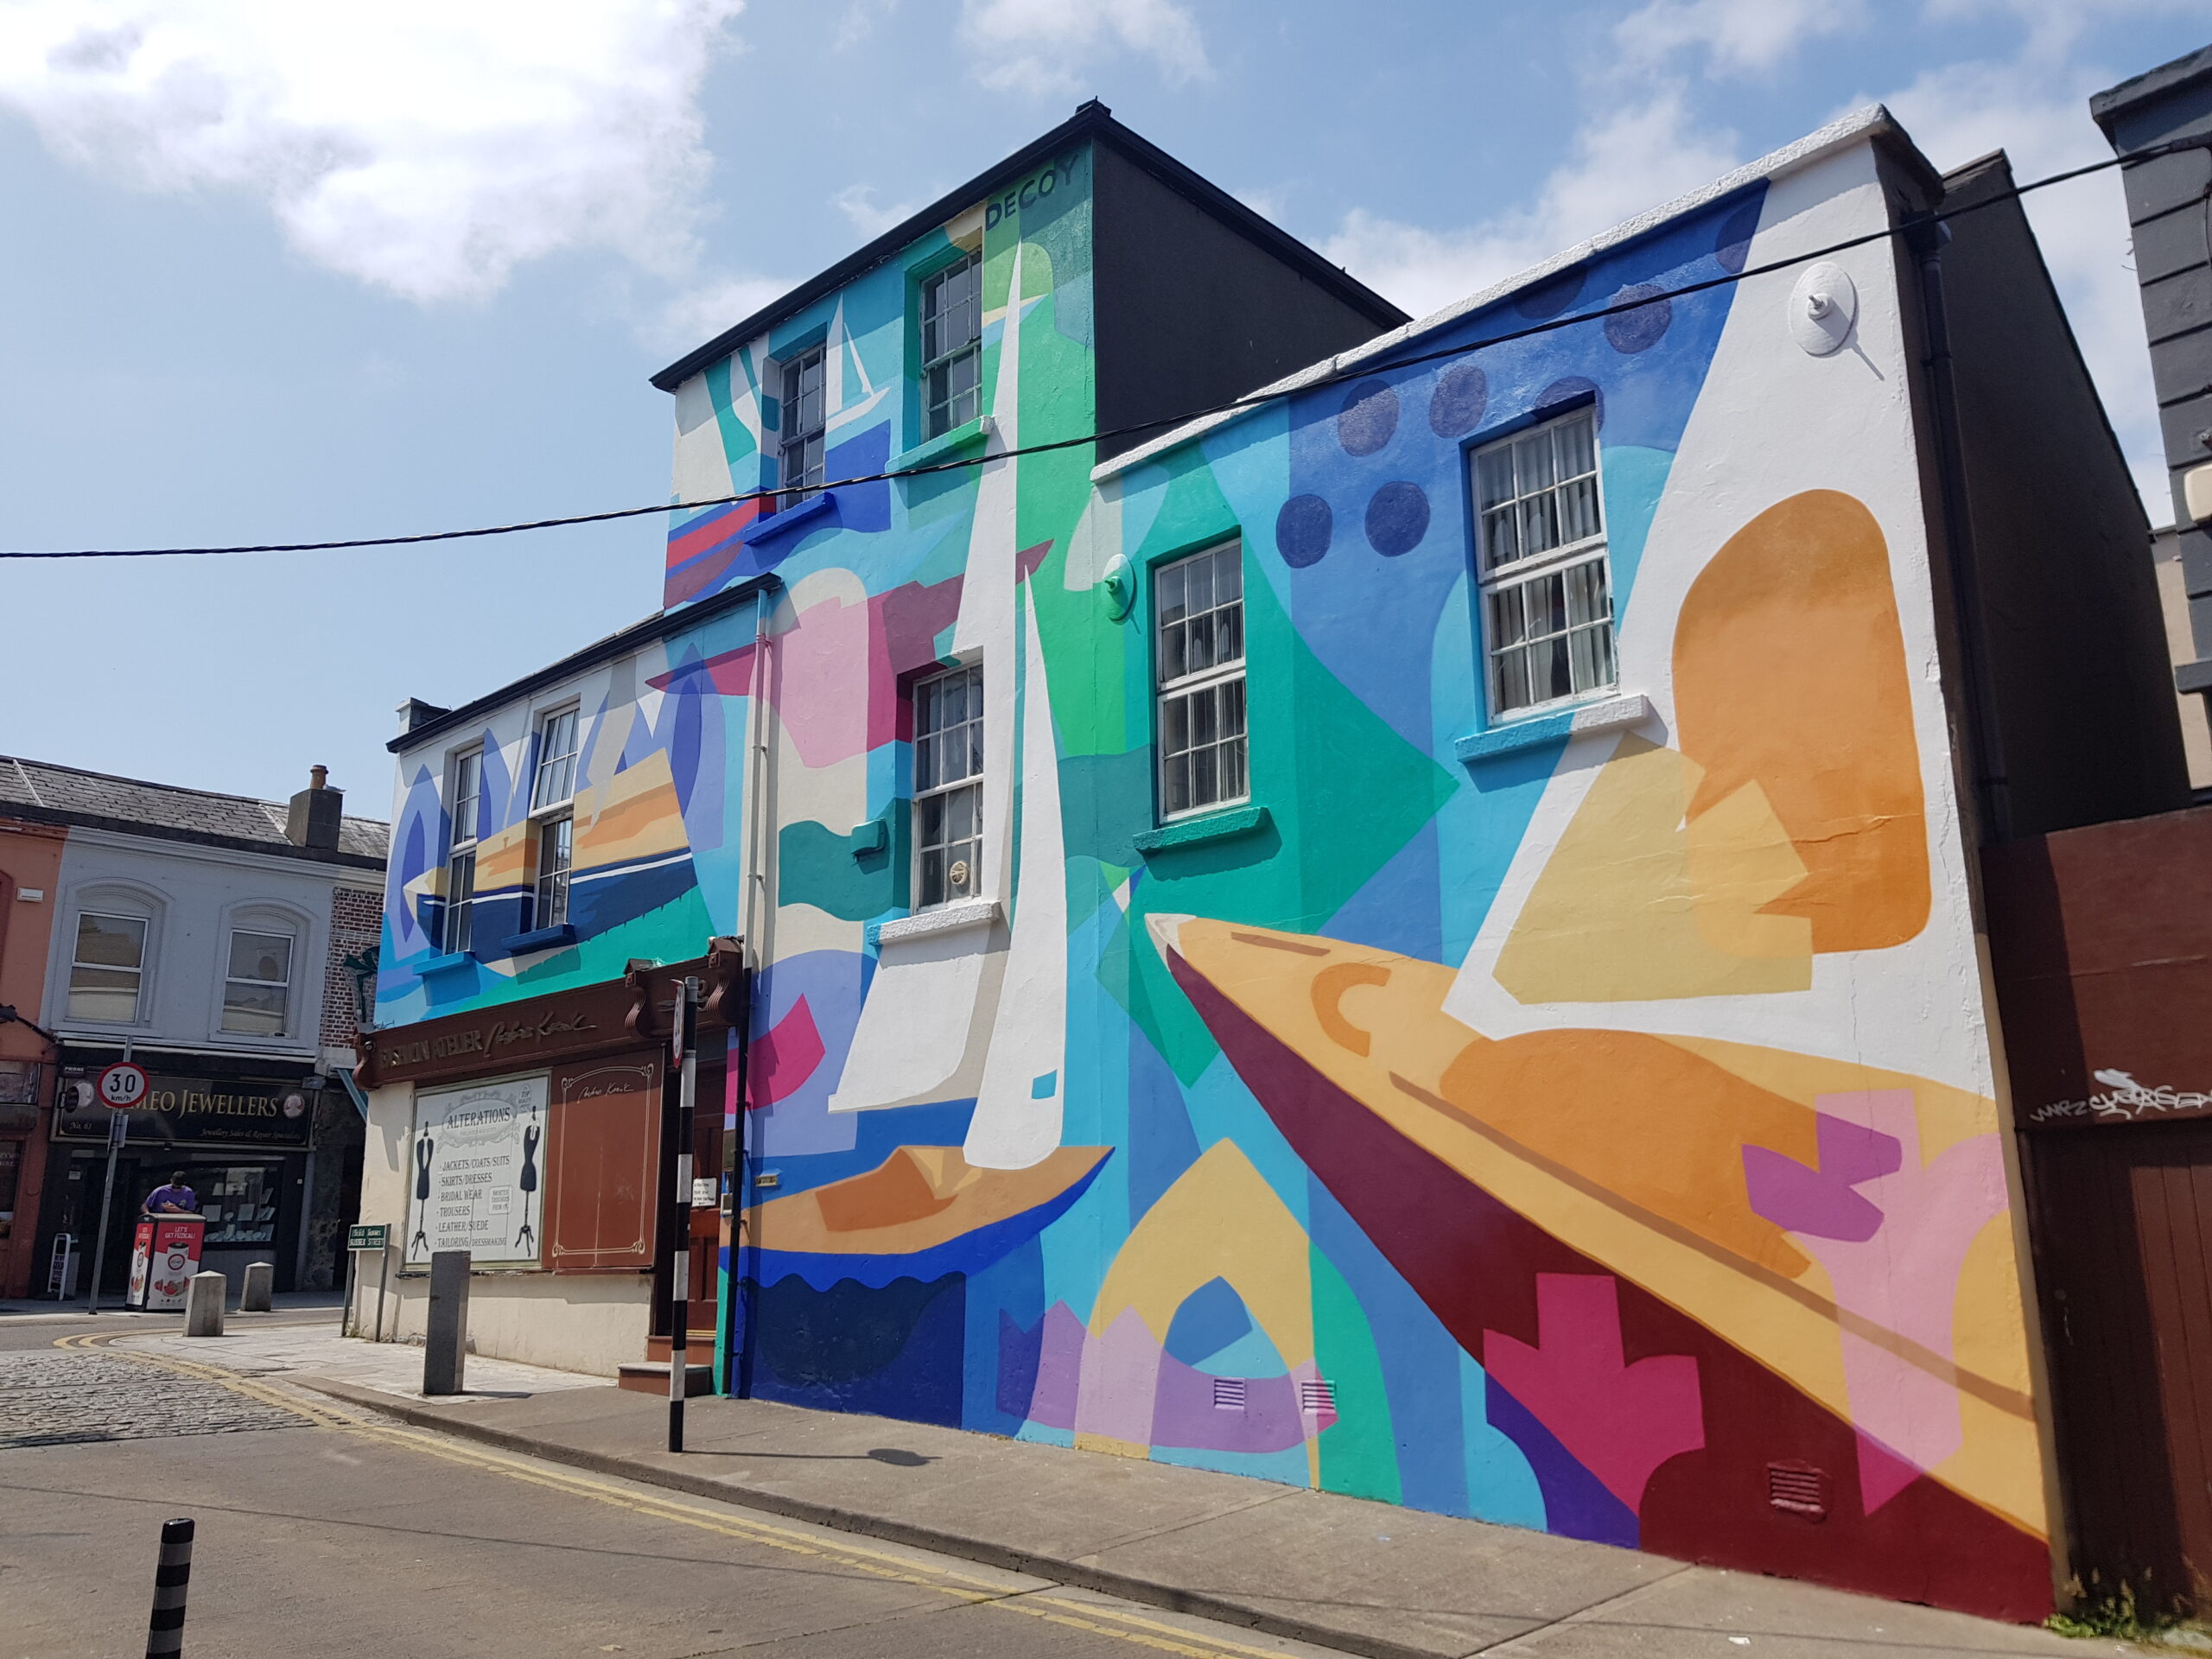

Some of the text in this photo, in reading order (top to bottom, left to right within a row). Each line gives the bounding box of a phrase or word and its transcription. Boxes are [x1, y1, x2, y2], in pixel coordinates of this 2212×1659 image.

[985, 154, 1079, 232] DECOY
[433, 1029, 484, 1059] ATELIER
[110, 1073, 137, 1093] 30
[178, 1090, 279, 1119] JEWELLERS
[447, 1107, 511, 1130] ALTERATIONS
[441, 1189, 482, 1202] BRIDAL WEAR
[440, 1205, 471, 1217] TROUSERS
